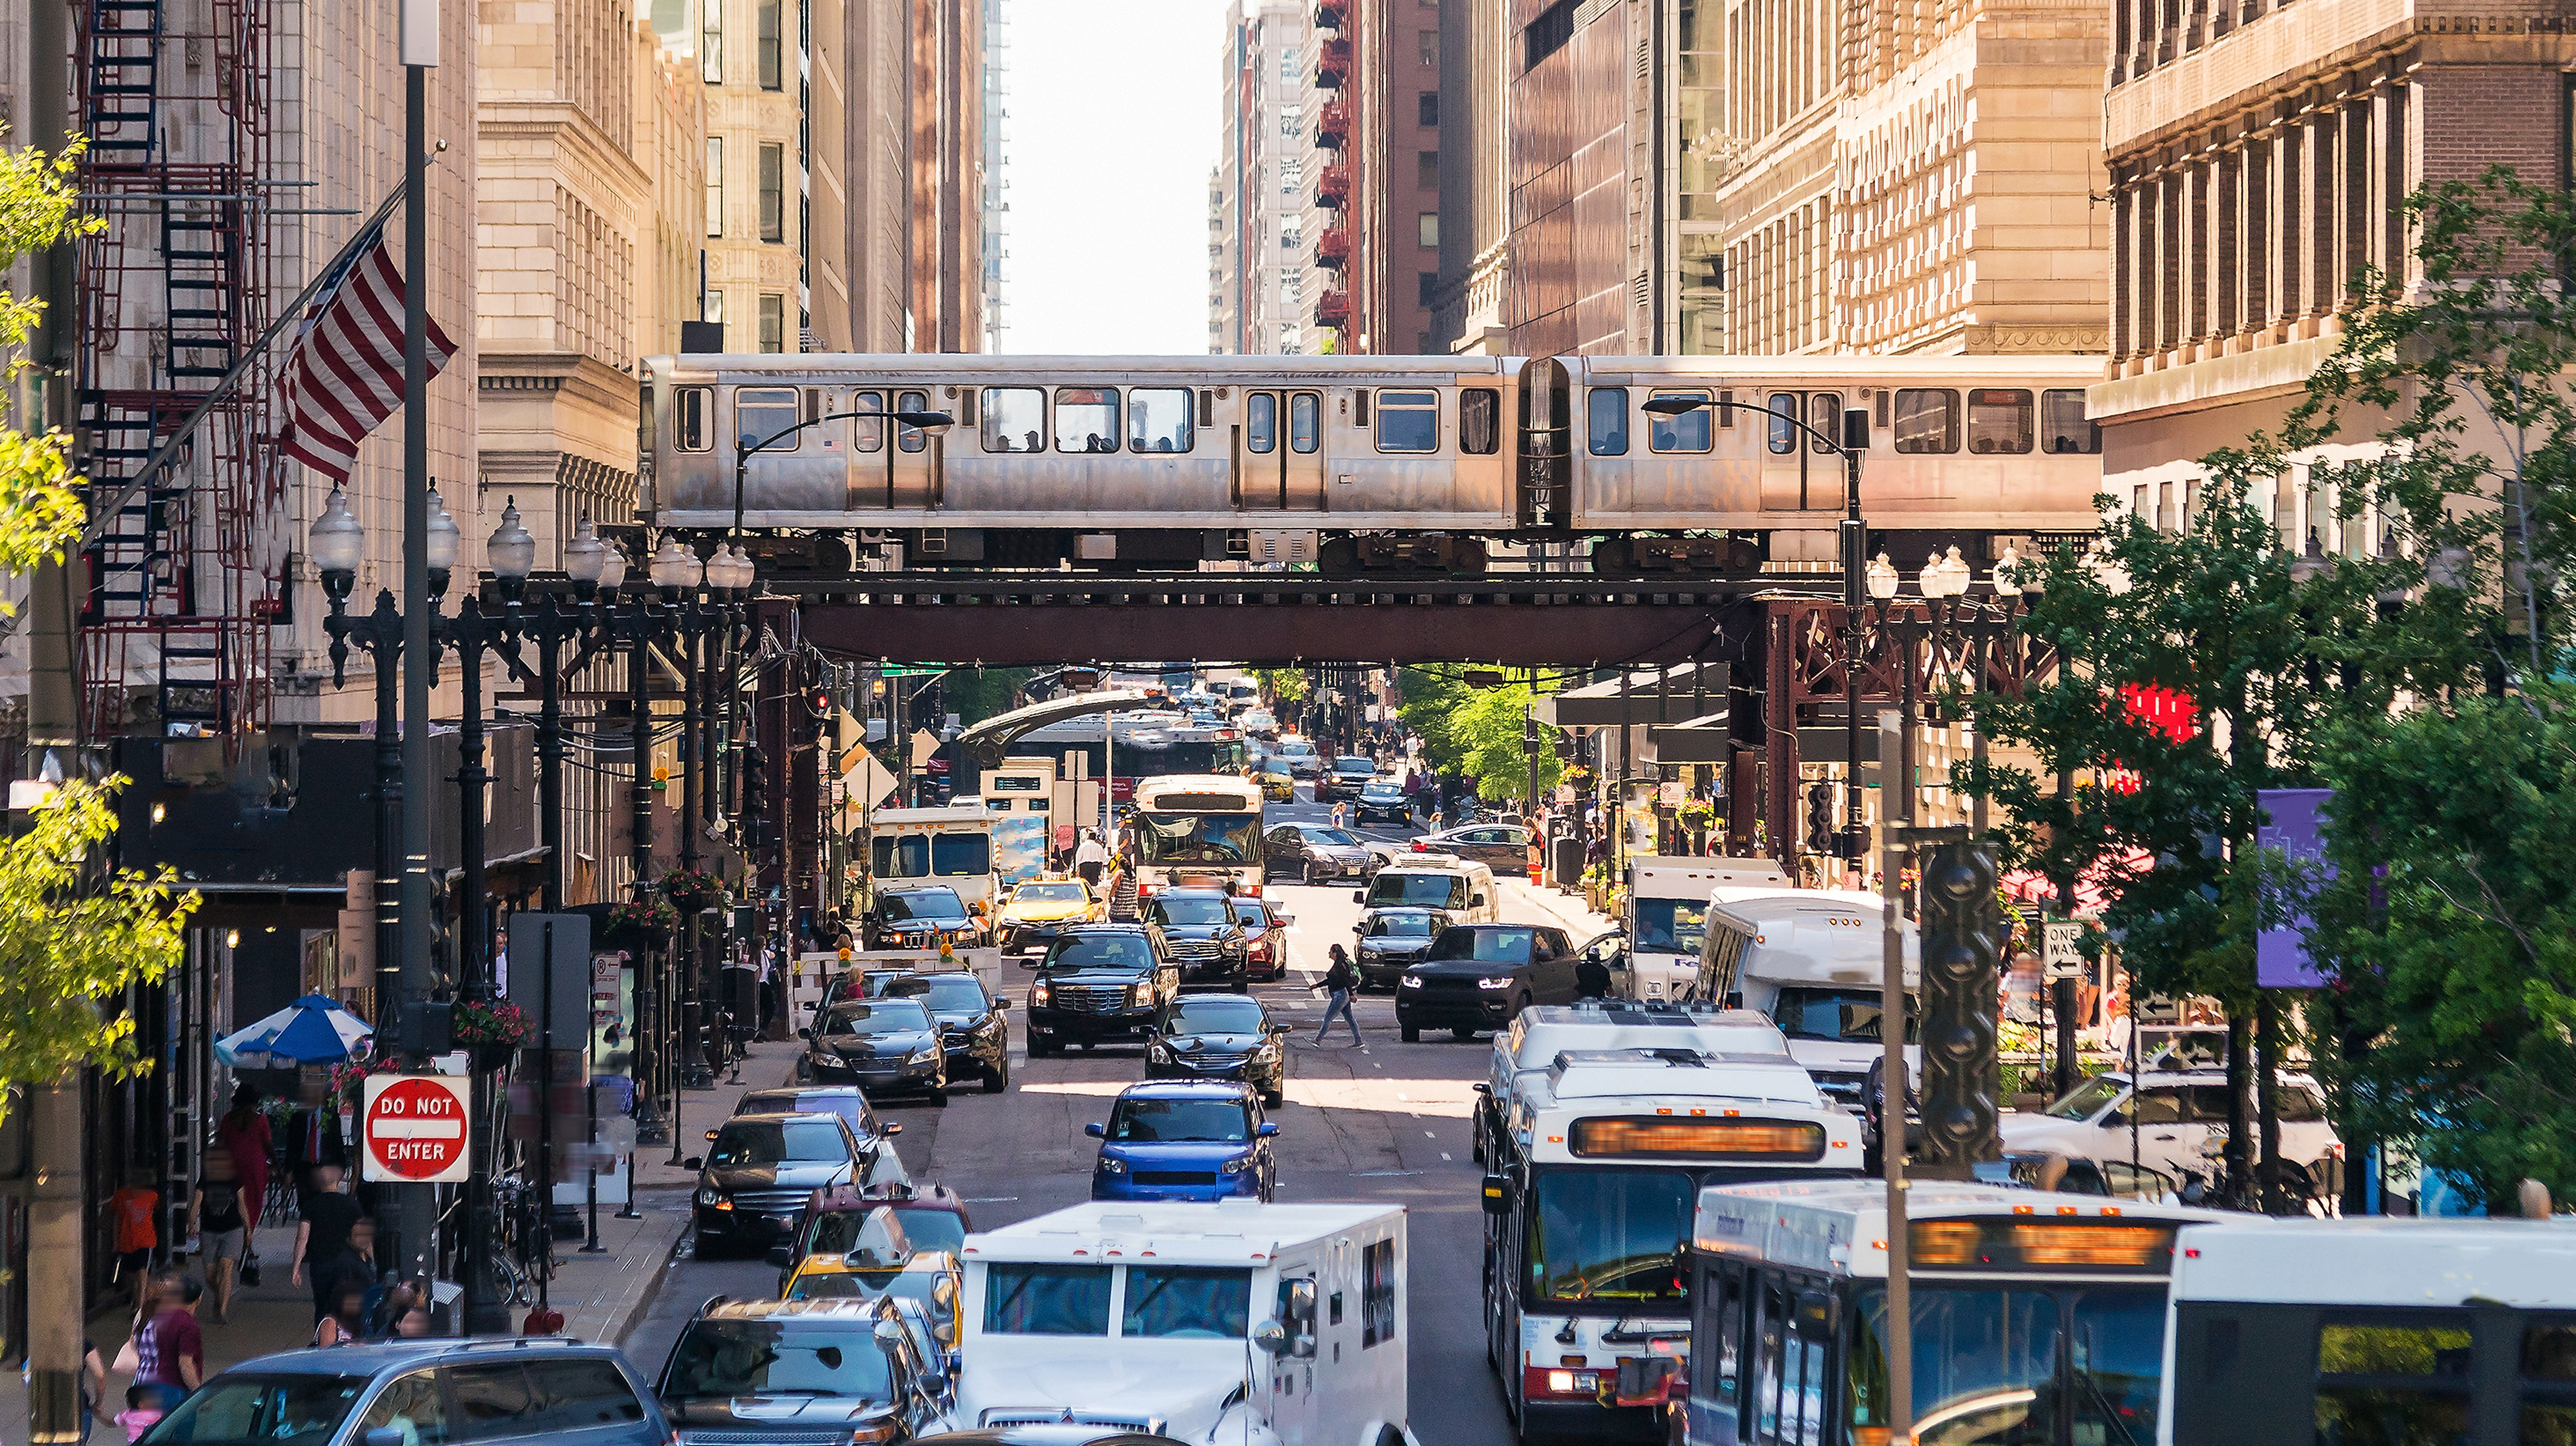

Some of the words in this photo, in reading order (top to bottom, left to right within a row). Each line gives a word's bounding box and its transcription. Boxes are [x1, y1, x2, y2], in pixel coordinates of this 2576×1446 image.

[2051, 929, 2077, 941] ONE
[2050, 944, 2076, 956] WAY
[381, 1096, 405, 1115] DO
[417, 1097, 453, 1115] NOT
[388, 1141, 445, 1160] ENTER
